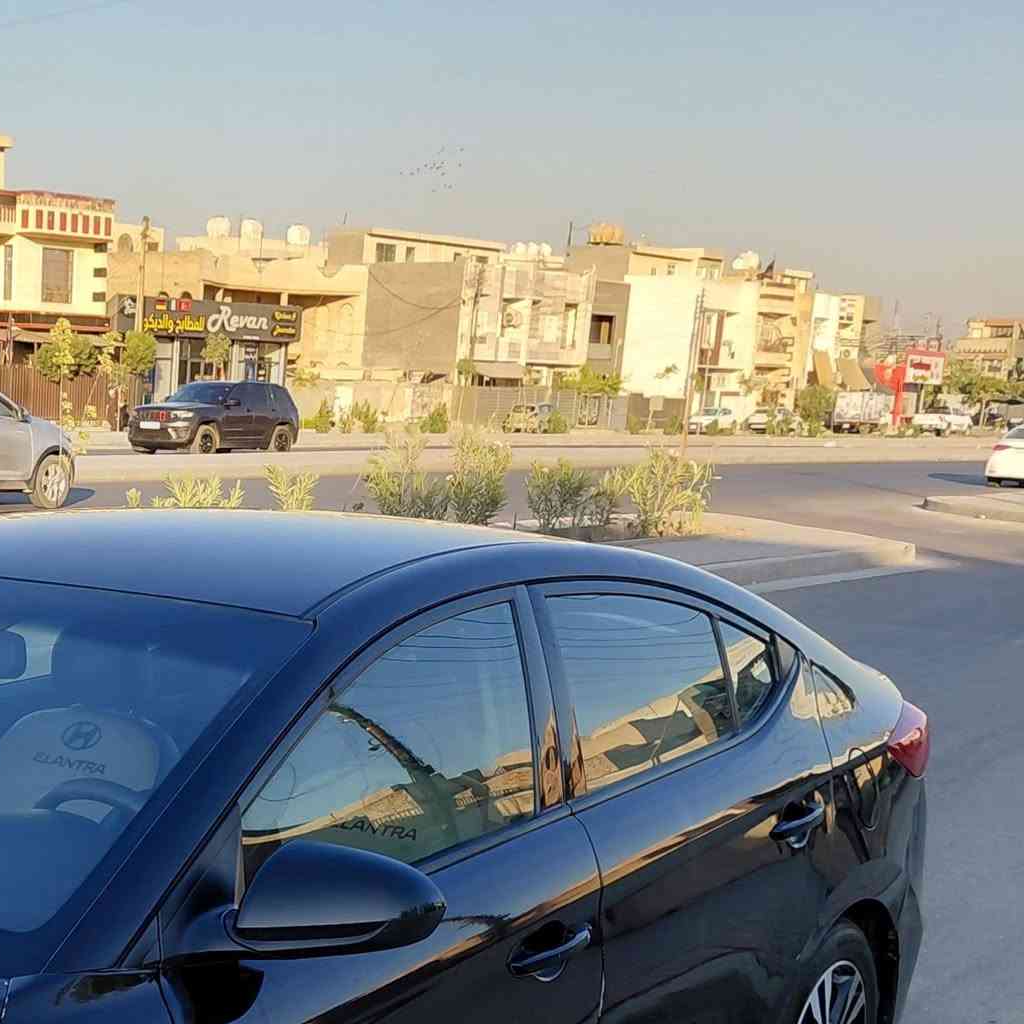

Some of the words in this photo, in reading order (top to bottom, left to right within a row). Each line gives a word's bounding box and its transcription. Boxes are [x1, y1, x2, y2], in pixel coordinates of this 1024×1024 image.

[207, 305, 268, 332] Revan
[31, 751, 107, 776] ELANTRA
[334, 815, 416, 840] LANTRA
